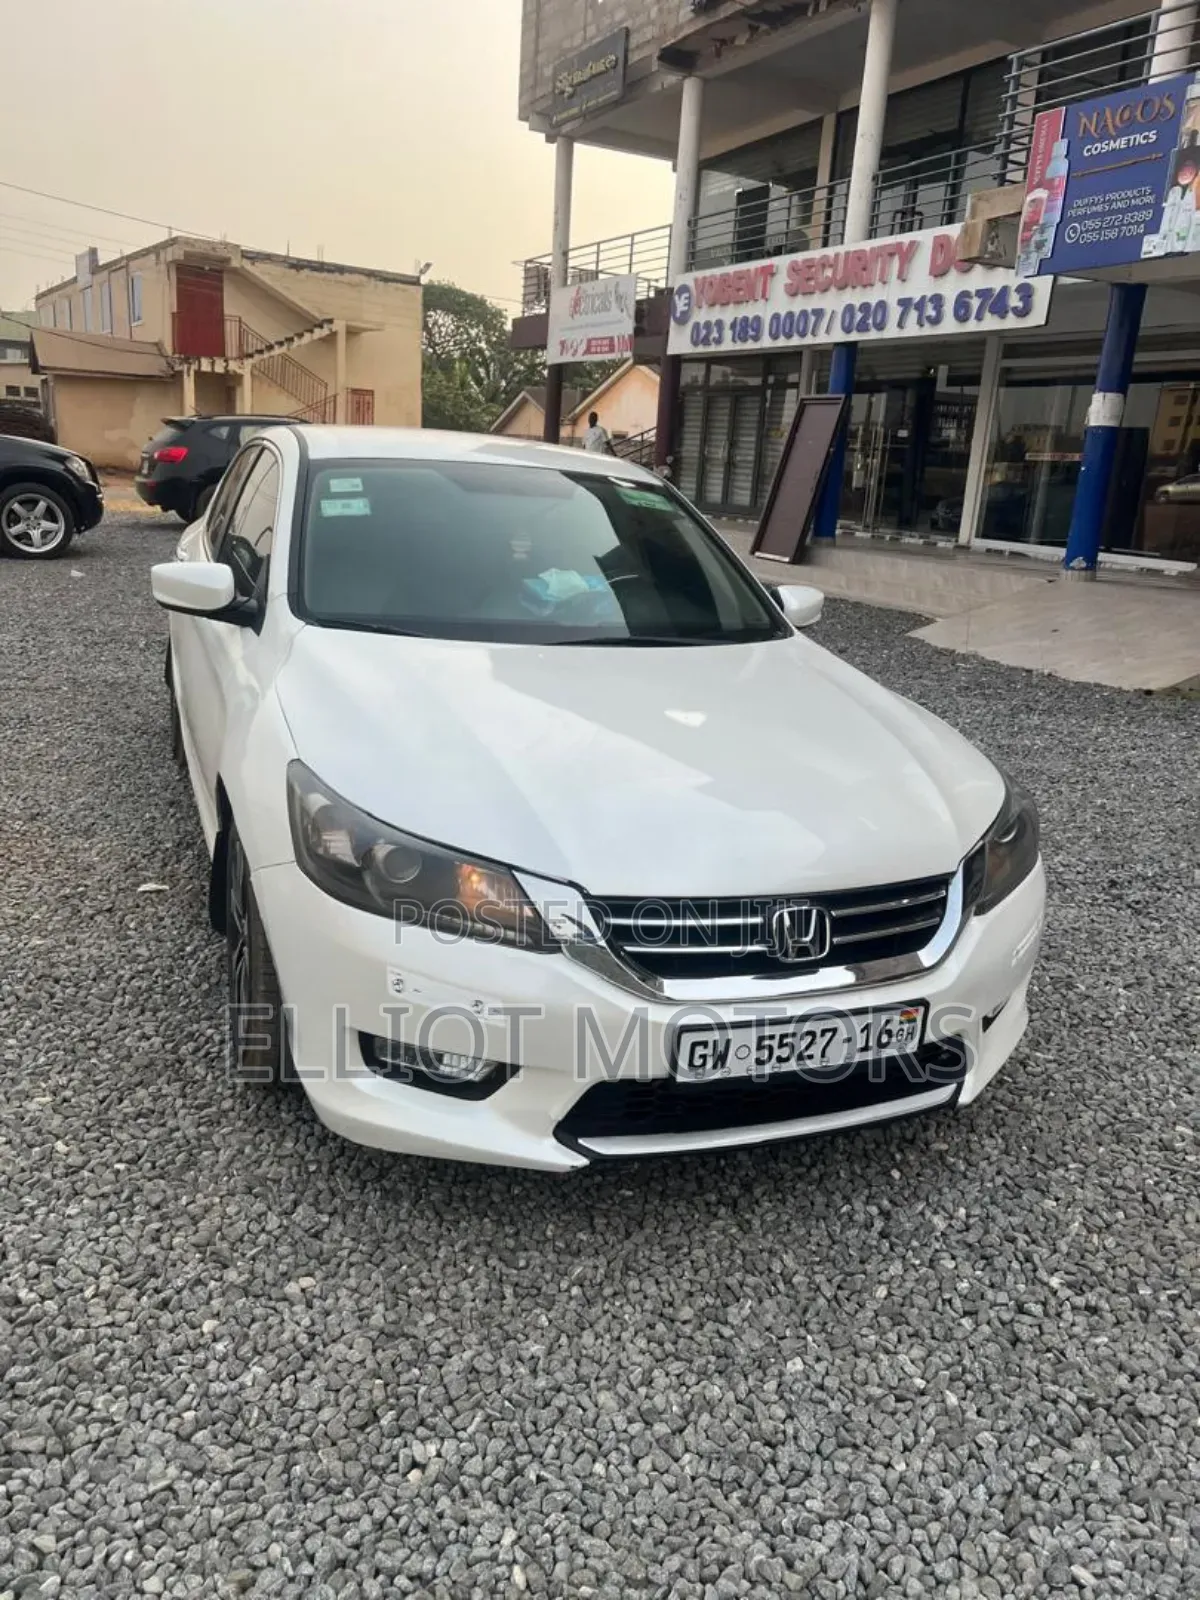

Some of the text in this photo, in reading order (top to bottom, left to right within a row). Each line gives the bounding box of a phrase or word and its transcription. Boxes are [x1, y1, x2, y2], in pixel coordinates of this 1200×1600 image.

[1083, 130, 1158, 157] COSMETICS
[1067, 194, 1156, 217] PERFUMES AND MORE
[1105, 186, 1153, 201] PRODUCTS
[1081, 209, 1153, 231] 055 272 8389
[1080, 223, 1145, 244] 055 158 7014
[784, 239, 920, 298] SECURITY
[690, 317, 725, 347] 023
[729, 314, 763, 344] 189
[768, 308, 825, 341] 0007
[840, 300, 888, 334] 020
[897, 293, 945, 330] 713
[953, 282, 1036, 324] 6743
[687, 1037, 732, 1070] GW
